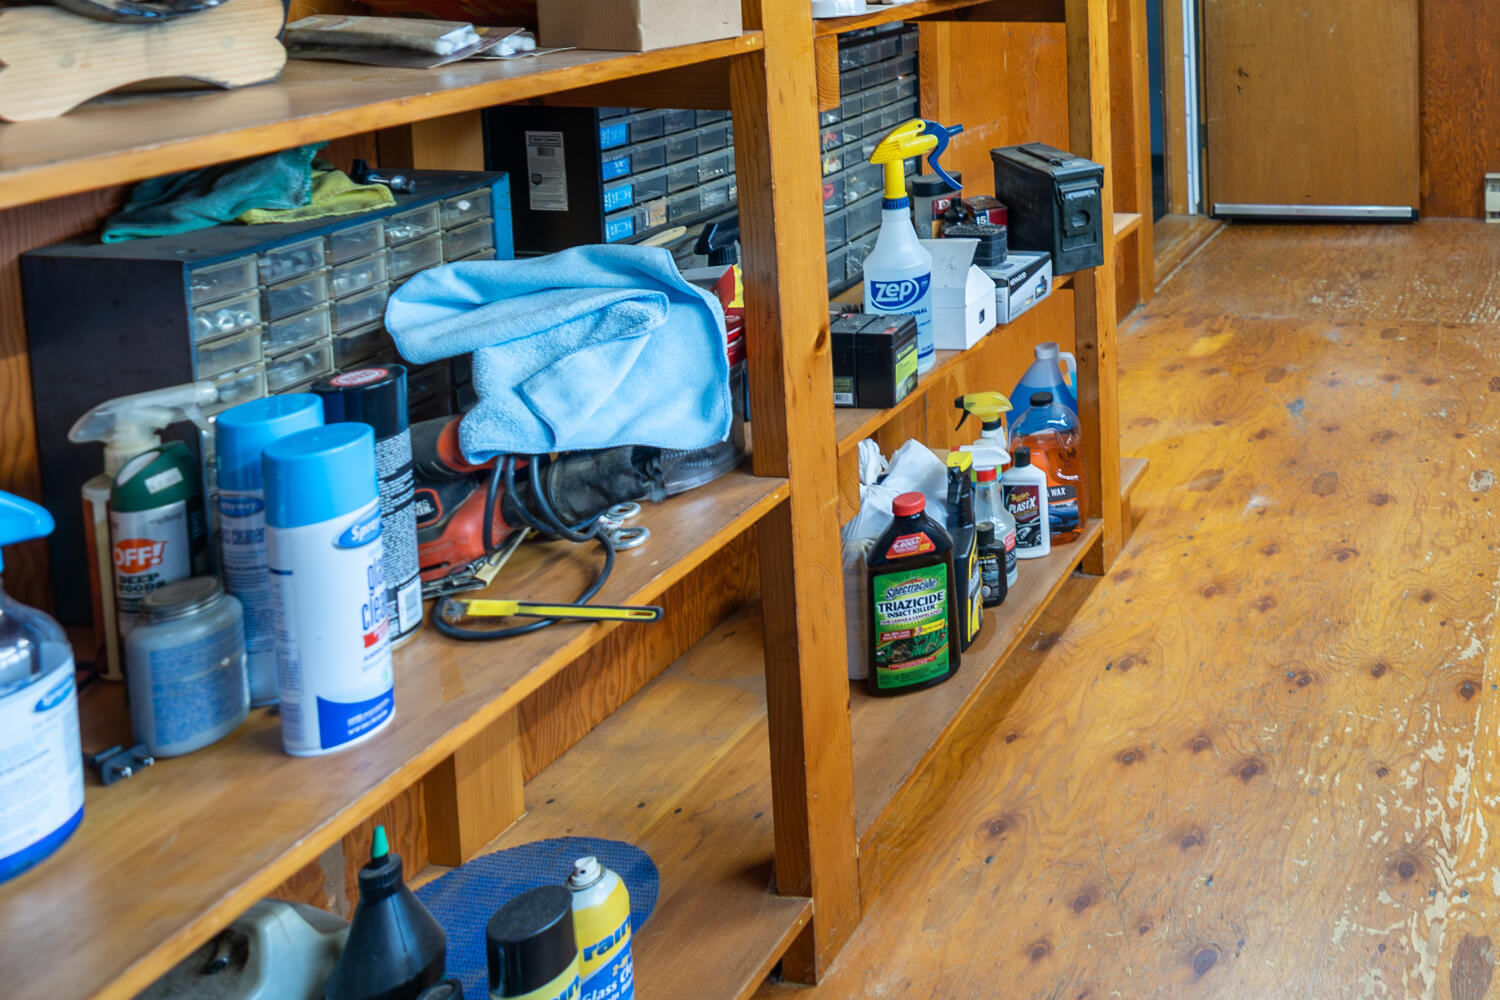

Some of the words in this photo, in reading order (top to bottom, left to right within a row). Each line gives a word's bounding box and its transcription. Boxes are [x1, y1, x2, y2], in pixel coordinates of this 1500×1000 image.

[1050, 487, 1066, 496] WAX
[113, 542, 162, 567] OFF!
[886, 577, 938, 599] Spectracide
[878, 592, 945, 613] TRIAZICIDE
[887, 608, 911, 619] INSECT
[912, 604, 936, 615] KILLER
